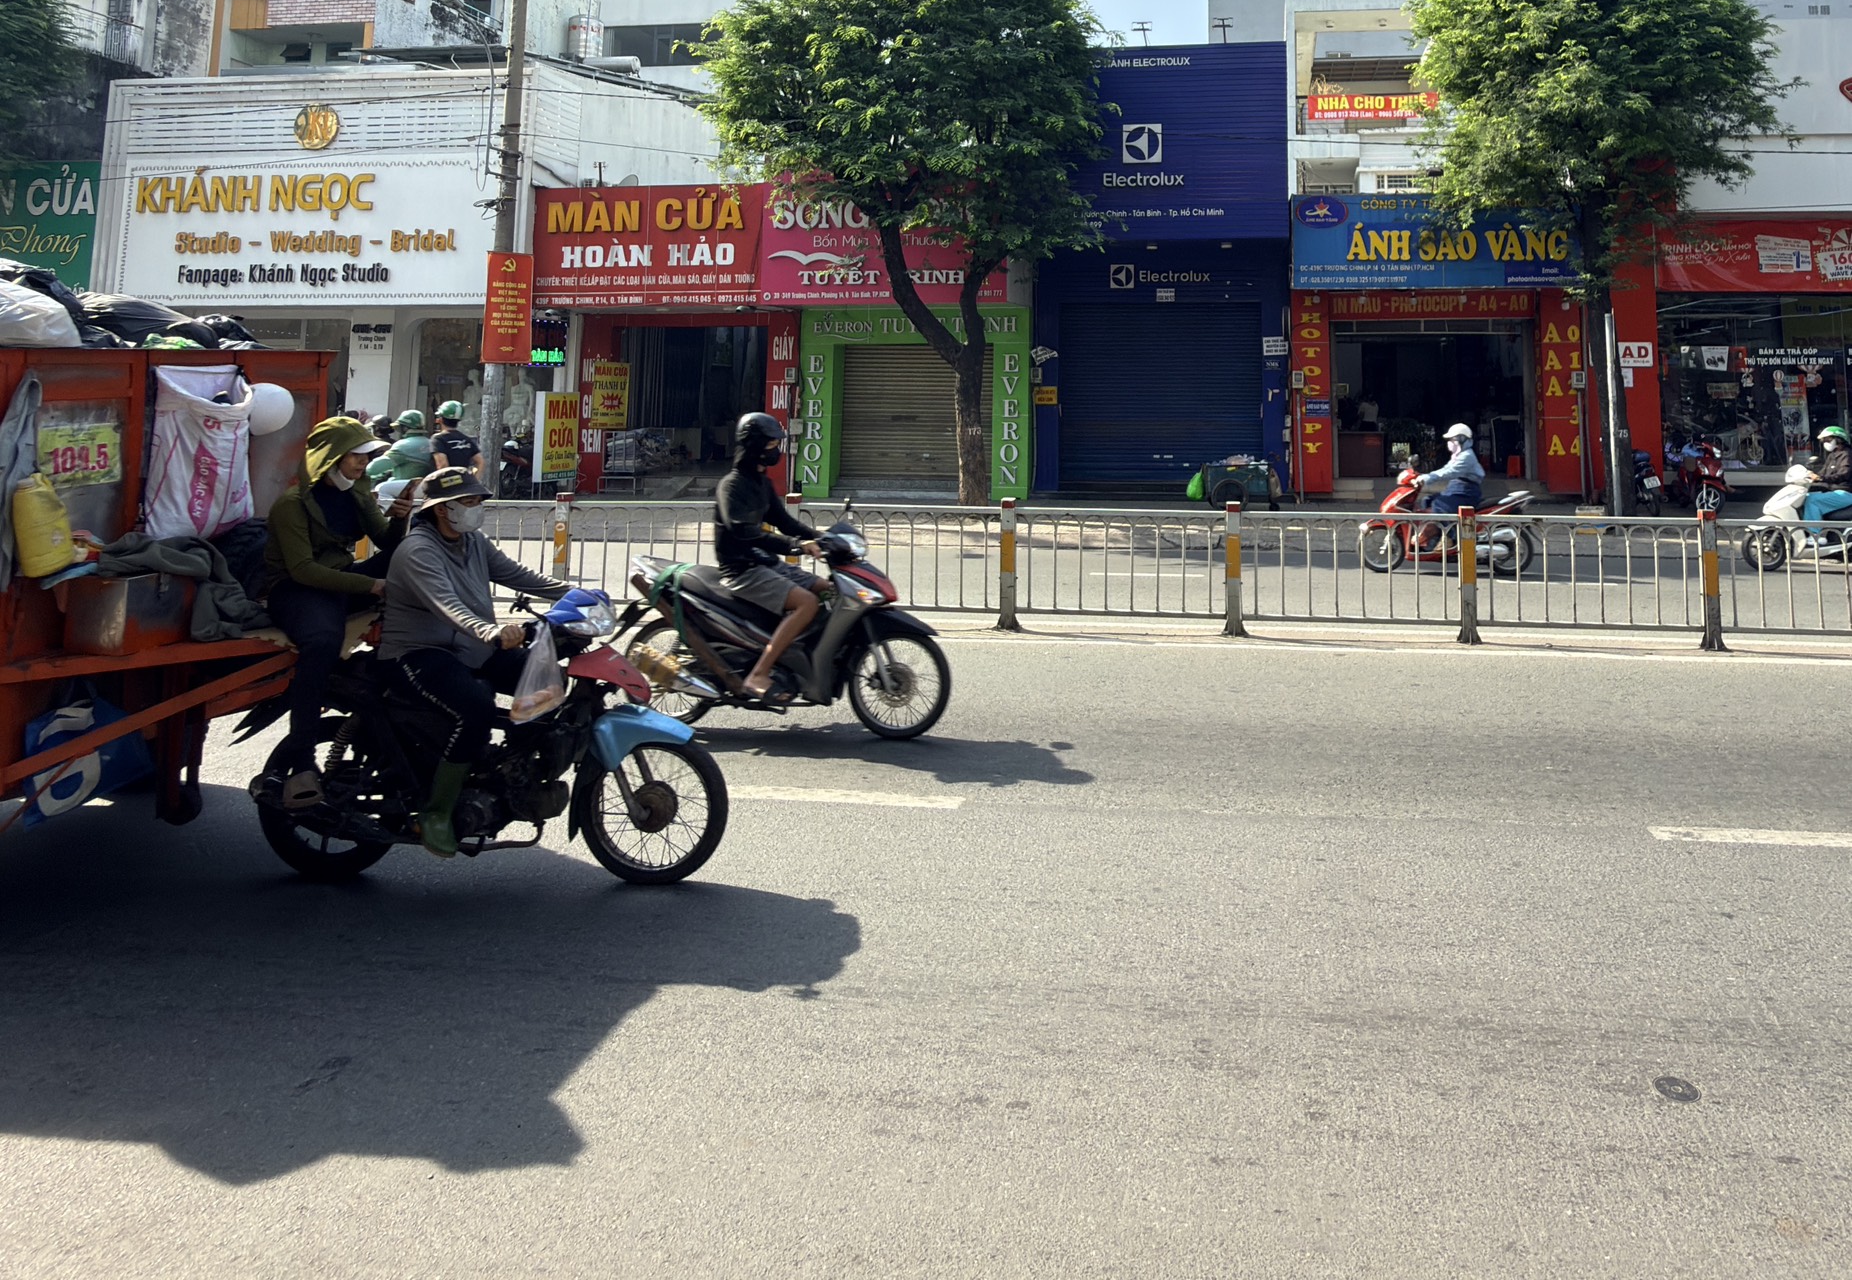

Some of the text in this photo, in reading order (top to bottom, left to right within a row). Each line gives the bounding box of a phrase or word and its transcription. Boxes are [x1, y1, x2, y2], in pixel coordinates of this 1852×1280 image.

[1133, 57, 1190, 67] ELECTROLUX
[1317, 93, 1428, 110] NHÀ CHO THUÊ
[26, 164, 95, 215] CỬA
[1103, 172, 1184, 187] Electrolux
[136, 166, 375, 220] KHÁNH NGỌC
[1361, 197, 1417, 210] CÔNG TY
[547, 187, 743, 233] MÀN CỬA
[1106, 209, 1127, 217] Chinh
[1169, 209, 1179, 217] Tp.
[1181, 207, 1190, 217] Hồ
[1207, 208, 1224, 216] Minh
[0, 224, 87, 264] Phong
[175, 229, 456, 256] Studio Wedding Bridal
[813, 232, 837, 248] Bốn
[1347, 222, 1568, 261] ÁNH SAO VÀNG
[1665, 243, 1692, 253] RINH
[1695, 239, 1719, 255] LỘC
[561, 236, 735, 269] HOÀN HẢO
[178, 263, 389, 288] Fanpage: Khánh Ngọc Studio
[798, 261, 965, 285] TUYẾT RINH
[1139, 270, 1210, 282] Electrolux
[617, 295, 628, 304] TÂN
[629, 295, 643, 304] BÌNH
[688, 295, 699, 303] 415
[700, 295, 711, 303] 045
[718, 295, 732, 303] 0973
[1333, 297, 1347, 314] IN
[1391, 295, 1464, 313] PHOTOCOPY
[1478, 295, 1497, 312] A4
[814, 317, 1016, 333] EVERON TNH
[773, 327, 794, 361] GIẤY
[1622, 345, 1649, 359] AD
[1759, 346, 1774, 355] BÁN
[1786, 346, 1801, 355] TRẢ
[1803, 346, 1818, 355] GÓP
[1744, 354, 1756, 365] THỦ
[1797, 355, 1809, 365] LẤY
[1809, 357, 1817, 365] XE
[1301, 296, 1323, 454] PHOTOCPY
[548, 396, 578, 419] MÀN
[802, 355, 824, 484] EVERON
[999, 353, 1020, 485] EVERON
[549, 421, 574, 449] CỬA
[968, 428, 981, 436] 173
